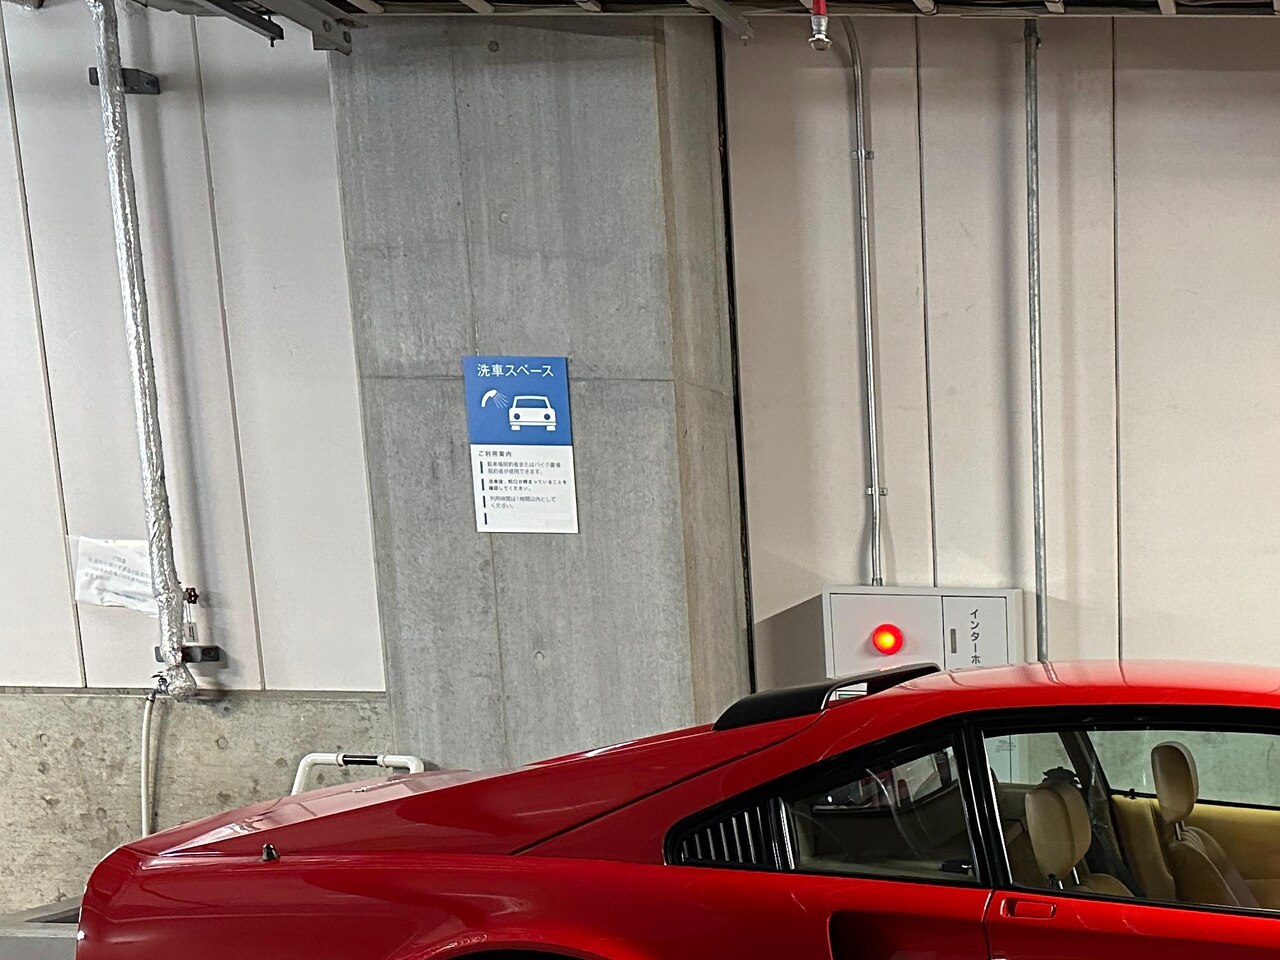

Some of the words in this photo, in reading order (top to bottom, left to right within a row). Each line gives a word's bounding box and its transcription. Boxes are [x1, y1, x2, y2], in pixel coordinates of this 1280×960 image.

[477, 364, 554, 377] 洗車スペース
[970, 608, 981, 665] インターホ
